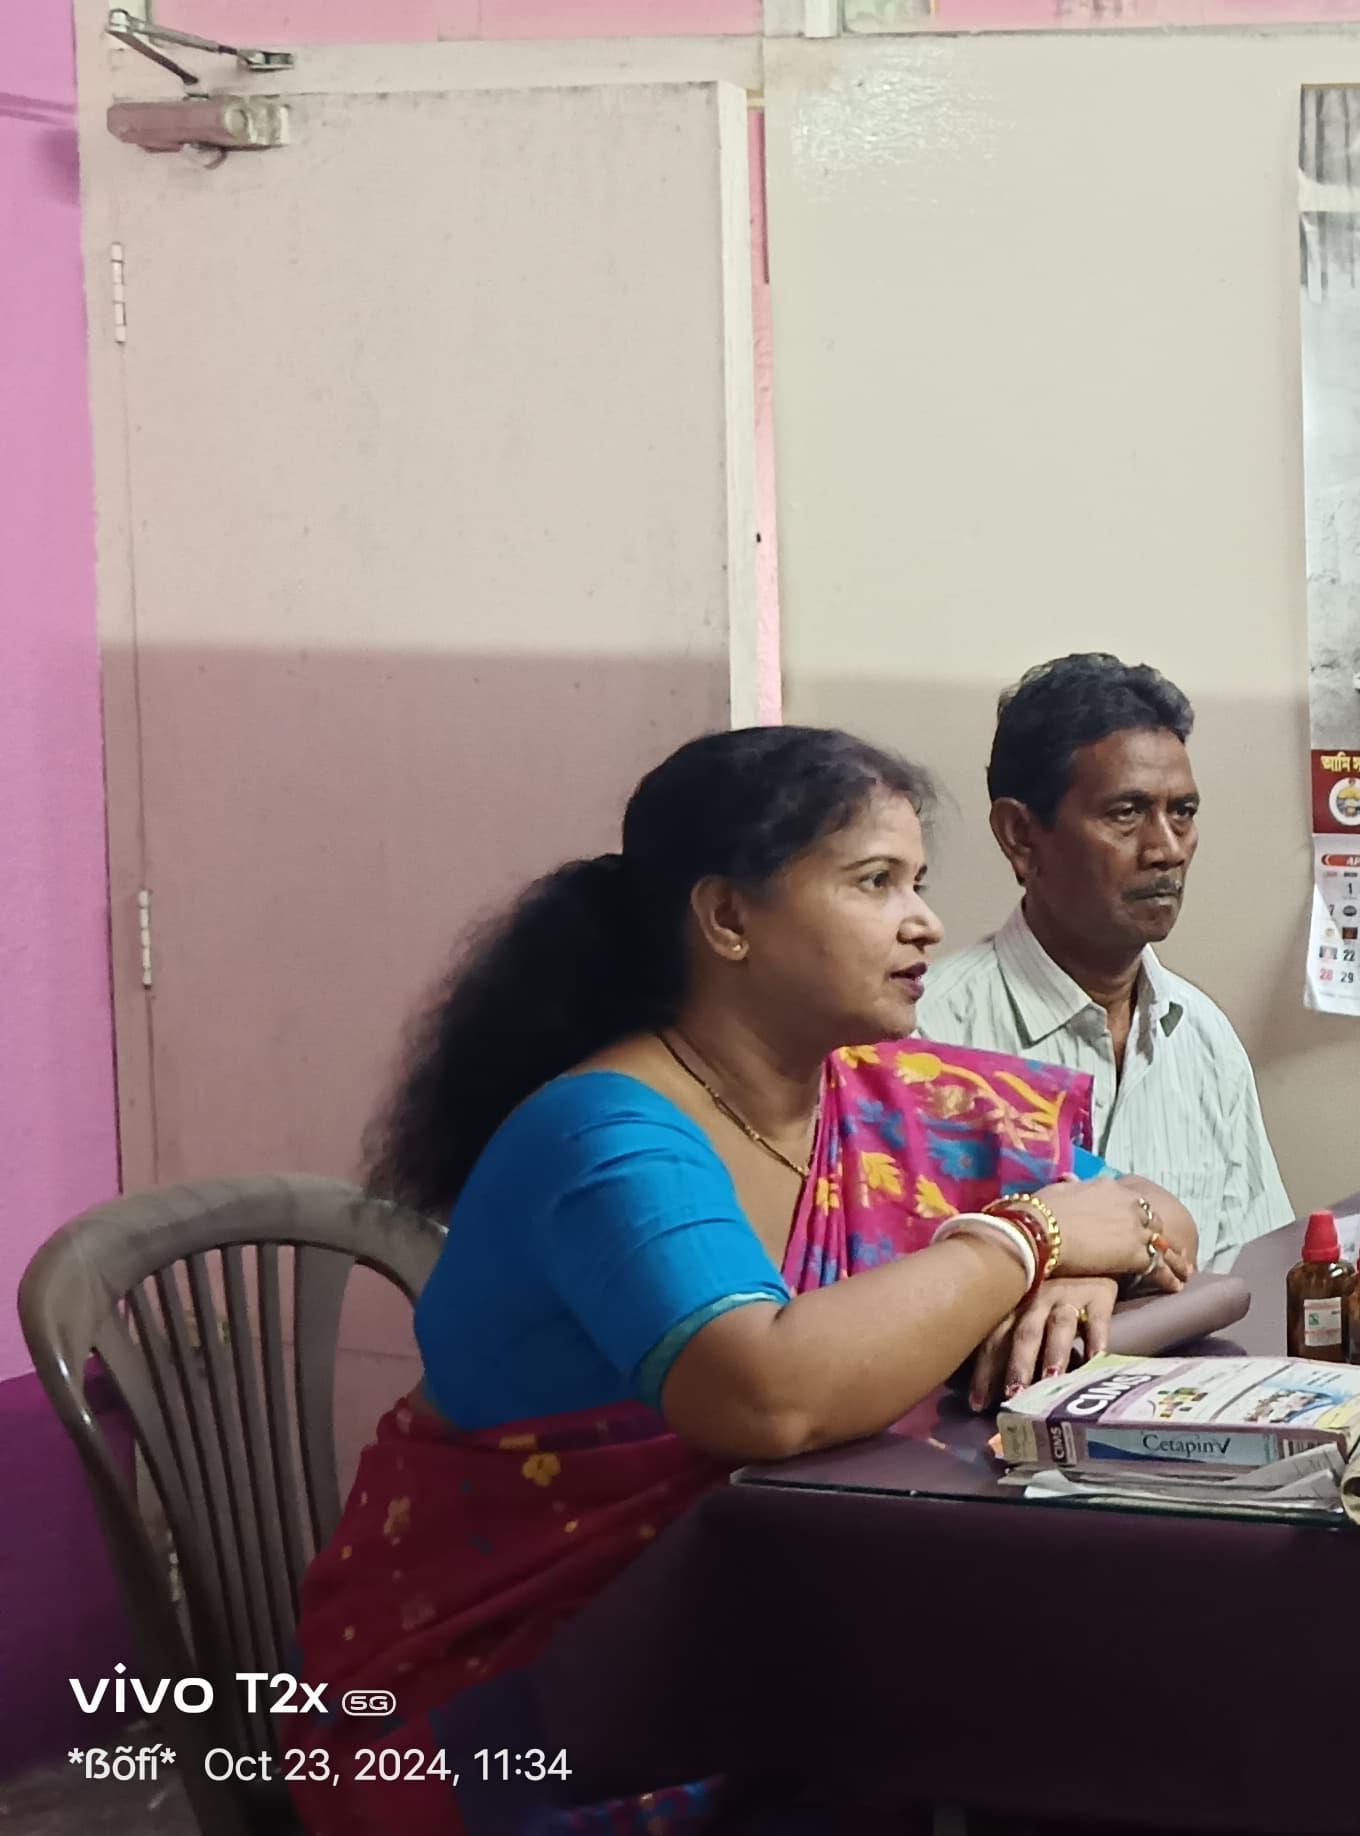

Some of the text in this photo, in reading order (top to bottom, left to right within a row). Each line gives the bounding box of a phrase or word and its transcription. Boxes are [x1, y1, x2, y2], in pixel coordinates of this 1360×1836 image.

[1320, 751, 1352, 773] আমি
[1343, 949, 1355, 962] 22
[1340, 972, 1354, 984] 29
[1065, 1374, 1152, 1416] CIMS
[1049, 1426, 1065, 1459] CIMS
